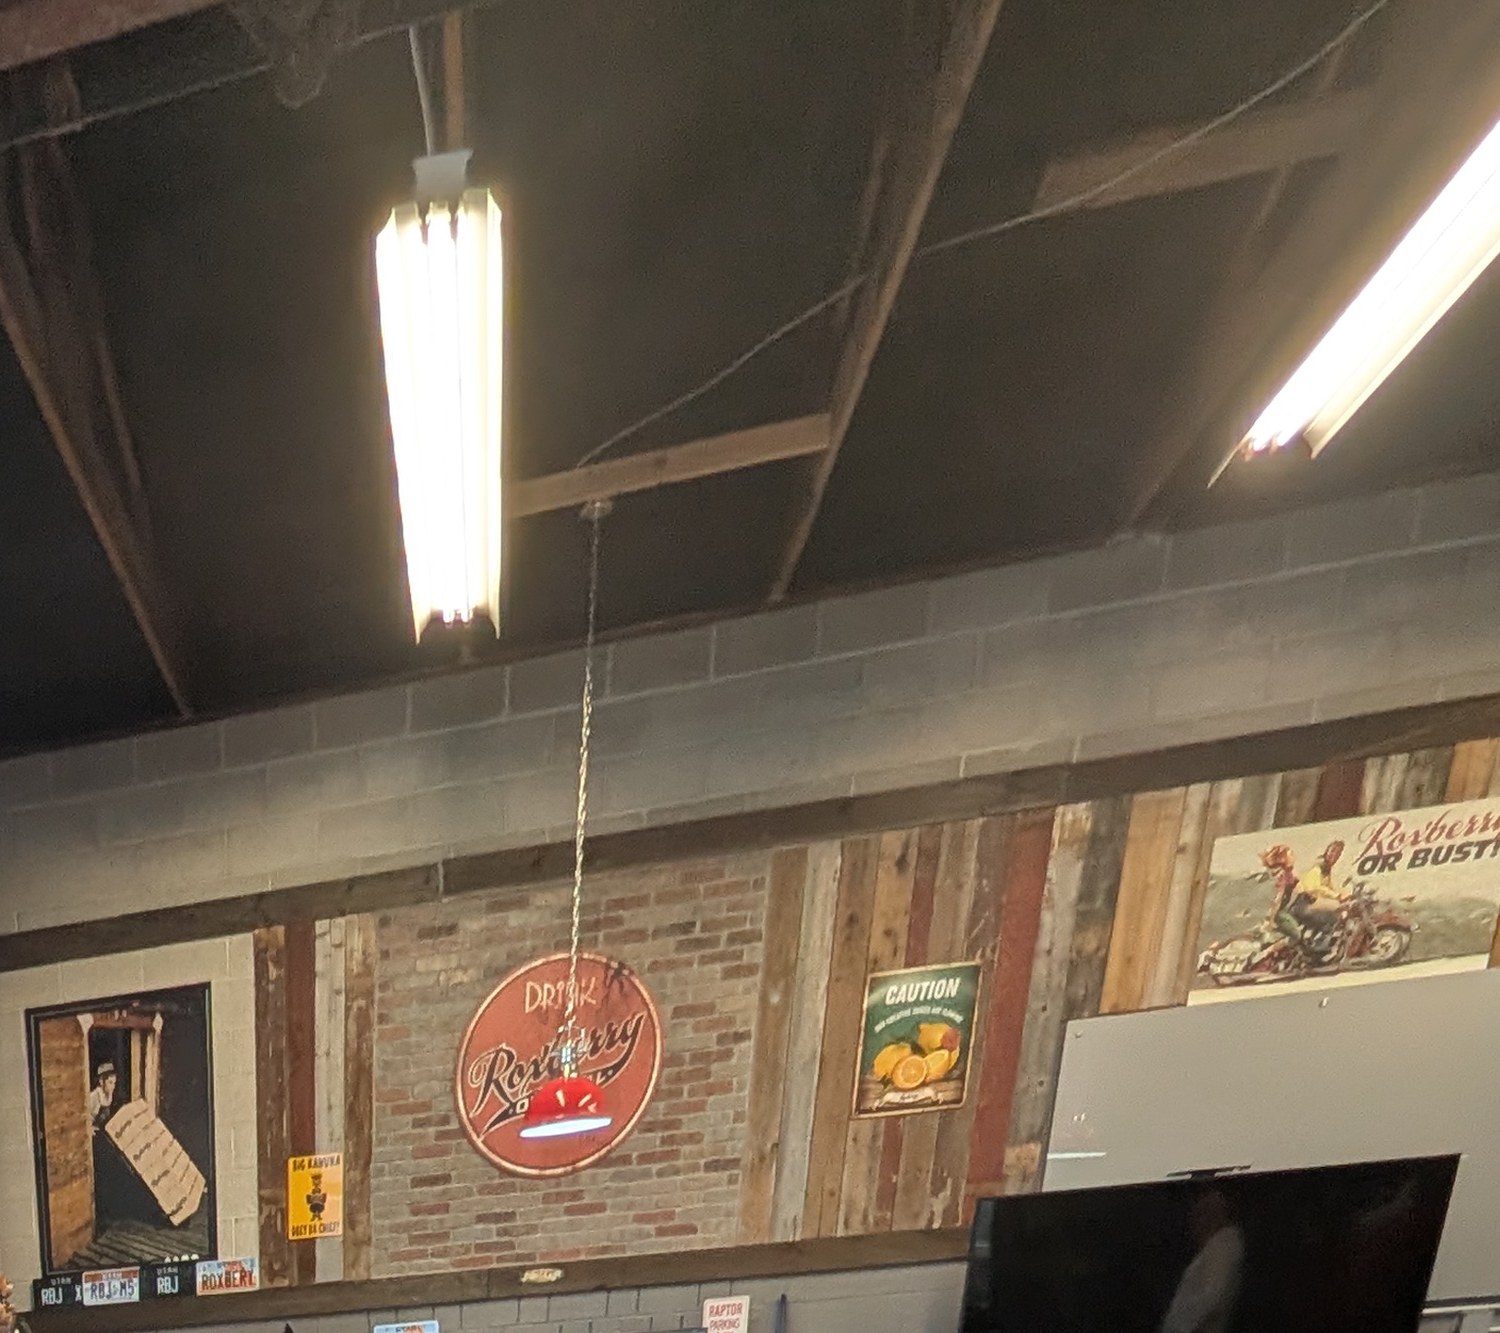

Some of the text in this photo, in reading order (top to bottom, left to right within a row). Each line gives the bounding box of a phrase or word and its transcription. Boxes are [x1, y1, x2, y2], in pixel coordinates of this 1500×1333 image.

[1352, 809, 1500, 866] Roxberr
[1357, 850, 1403, 876] OR
[885, 977, 961, 1005] CAUTION
[90, 1282, 113, 1300] RBJ
[157, 1275, 179, 1295] RBJ
[41, 1287, 63, 1306] RBJ
[709, 1303, 743, 1317] RAPTOR
[709, 1318, 740, 1331] PARKING
